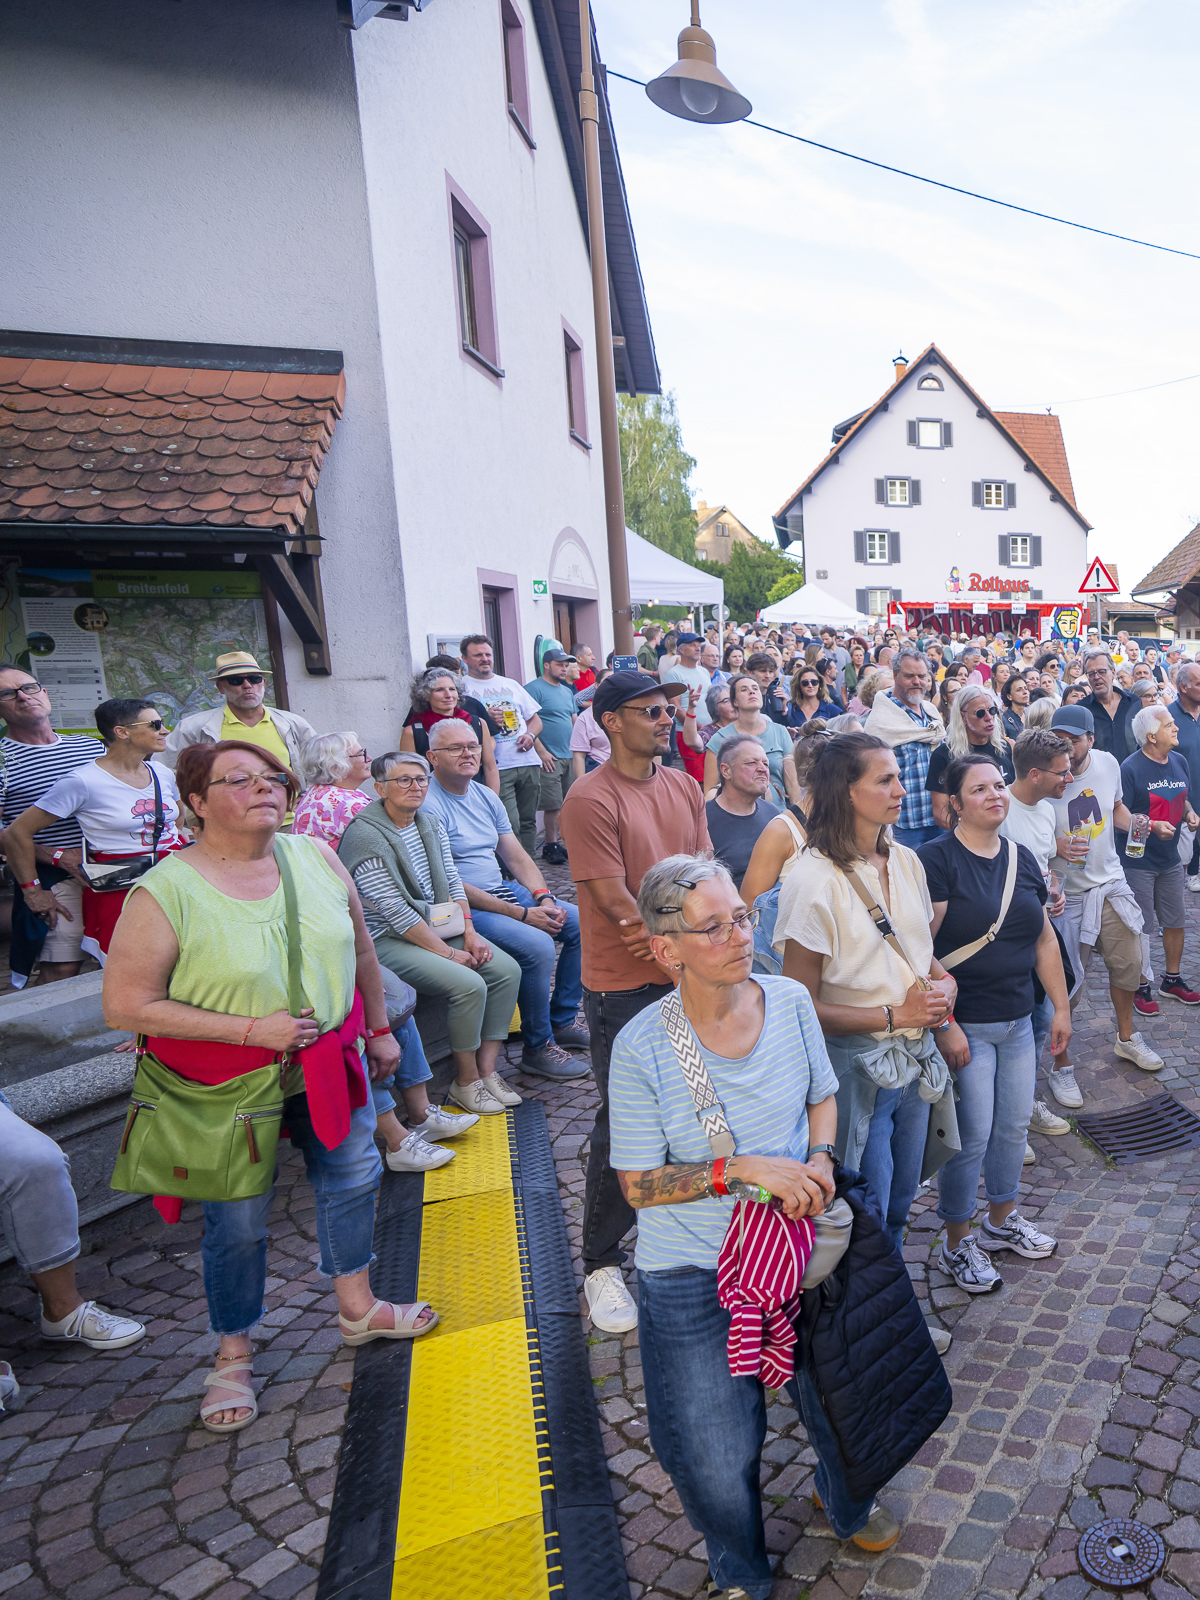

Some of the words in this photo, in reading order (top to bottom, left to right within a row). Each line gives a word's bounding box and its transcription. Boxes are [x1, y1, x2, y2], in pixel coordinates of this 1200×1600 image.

[95, 573, 147, 582] Willkommen
[149, 574, 157, 582] in
[117, 582, 190, 594] Breitenfeld
[968, 573, 1029, 595] Rothaus
[1147, 779, 1187, 791] Jack&Jones
